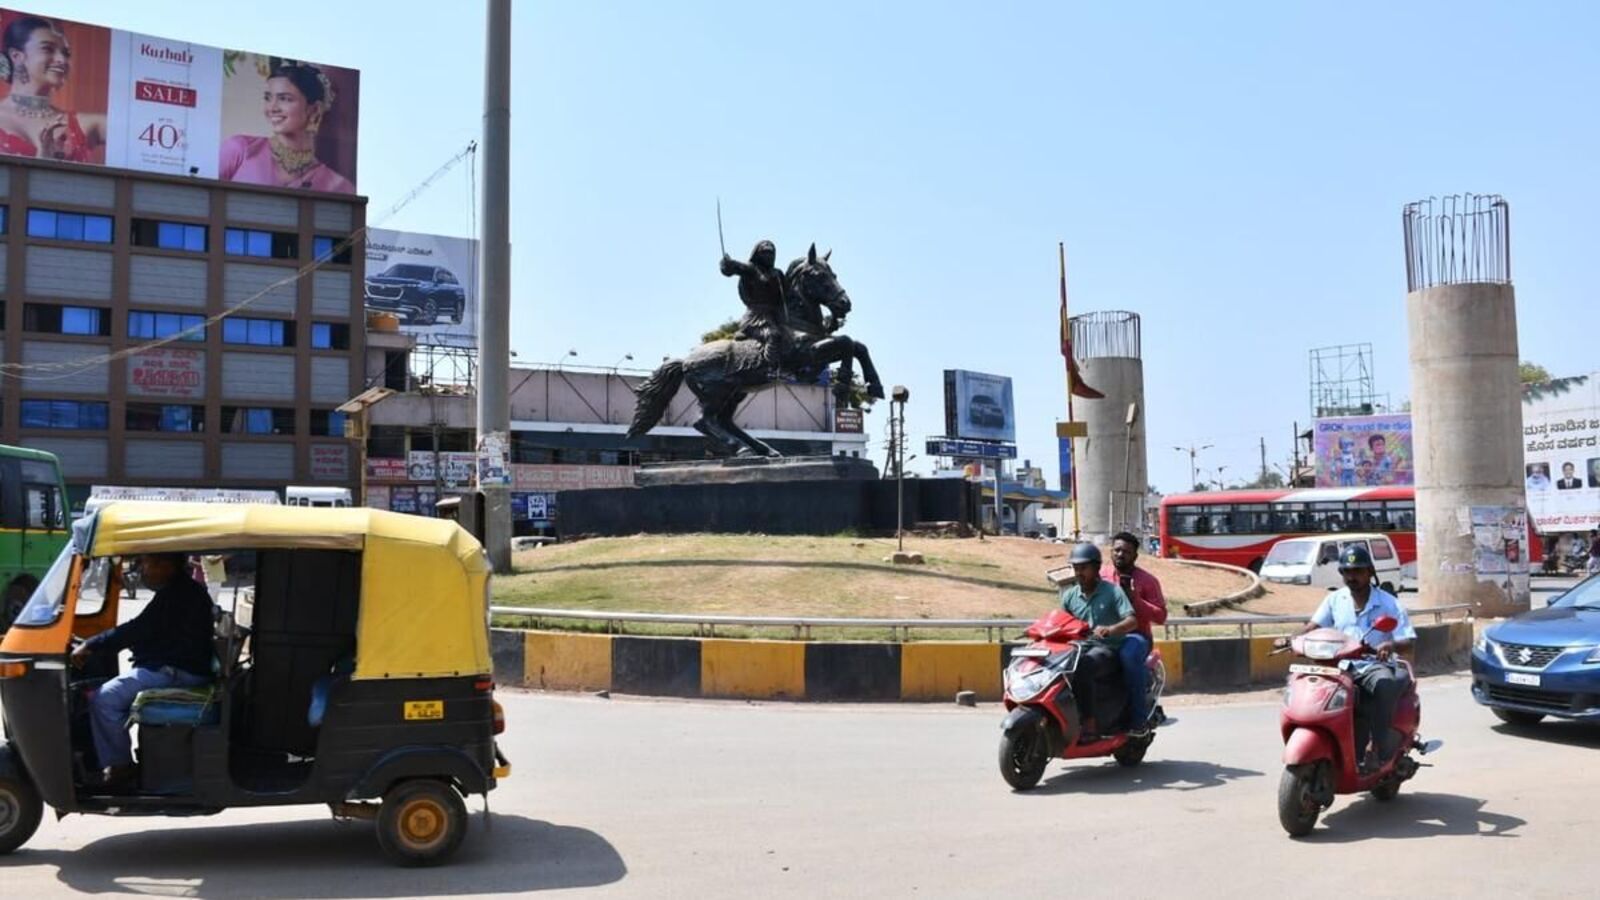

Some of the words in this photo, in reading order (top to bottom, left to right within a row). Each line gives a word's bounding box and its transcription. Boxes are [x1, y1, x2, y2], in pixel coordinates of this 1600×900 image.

[142, 84, 190, 105] SALE
[1377, 422, 1390, 430] the
[1557, 435, 1597, 449] ವರ್ಷದ
